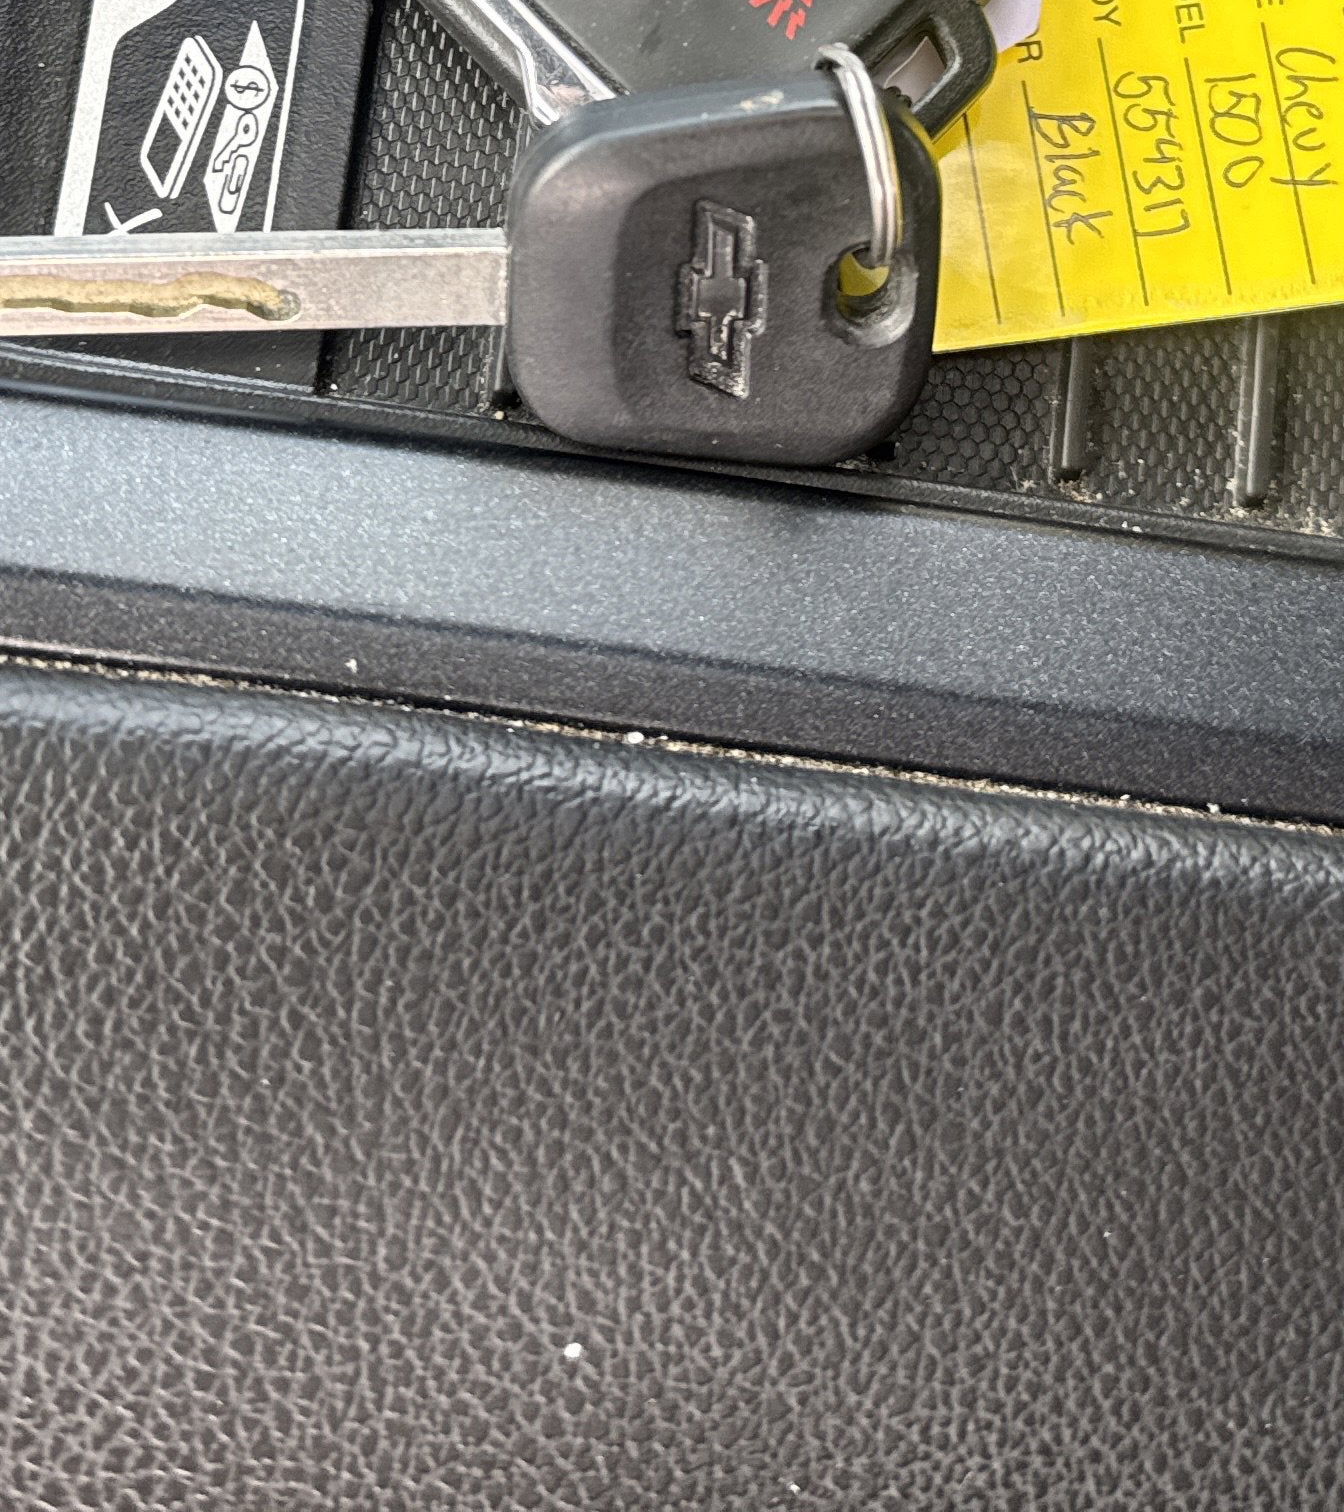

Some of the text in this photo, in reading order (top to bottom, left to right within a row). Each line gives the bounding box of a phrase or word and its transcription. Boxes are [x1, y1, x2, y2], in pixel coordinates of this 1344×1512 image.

[1029, 106, 1114, 245] Black
[1204, 73, 1264, 188] 1500
[1269, 47, 1339, 186] Chevy
